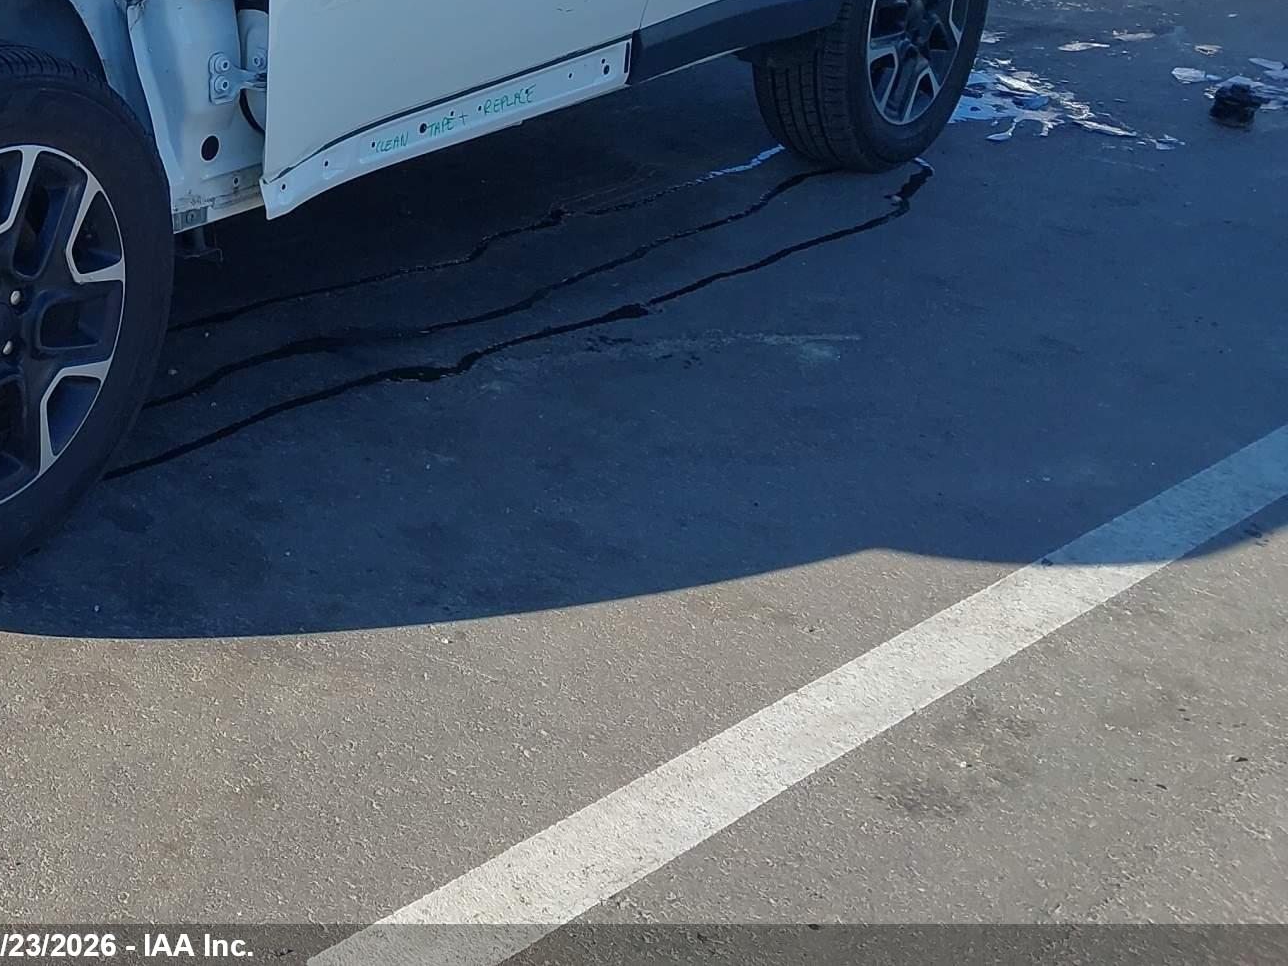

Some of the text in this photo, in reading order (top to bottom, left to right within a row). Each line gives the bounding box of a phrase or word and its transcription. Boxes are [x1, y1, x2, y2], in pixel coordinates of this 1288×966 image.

[375, 131, 409, 153] CLEAN
[427, 114, 456, 137] TAPE
[483, 83, 537, 115] REPLACE
